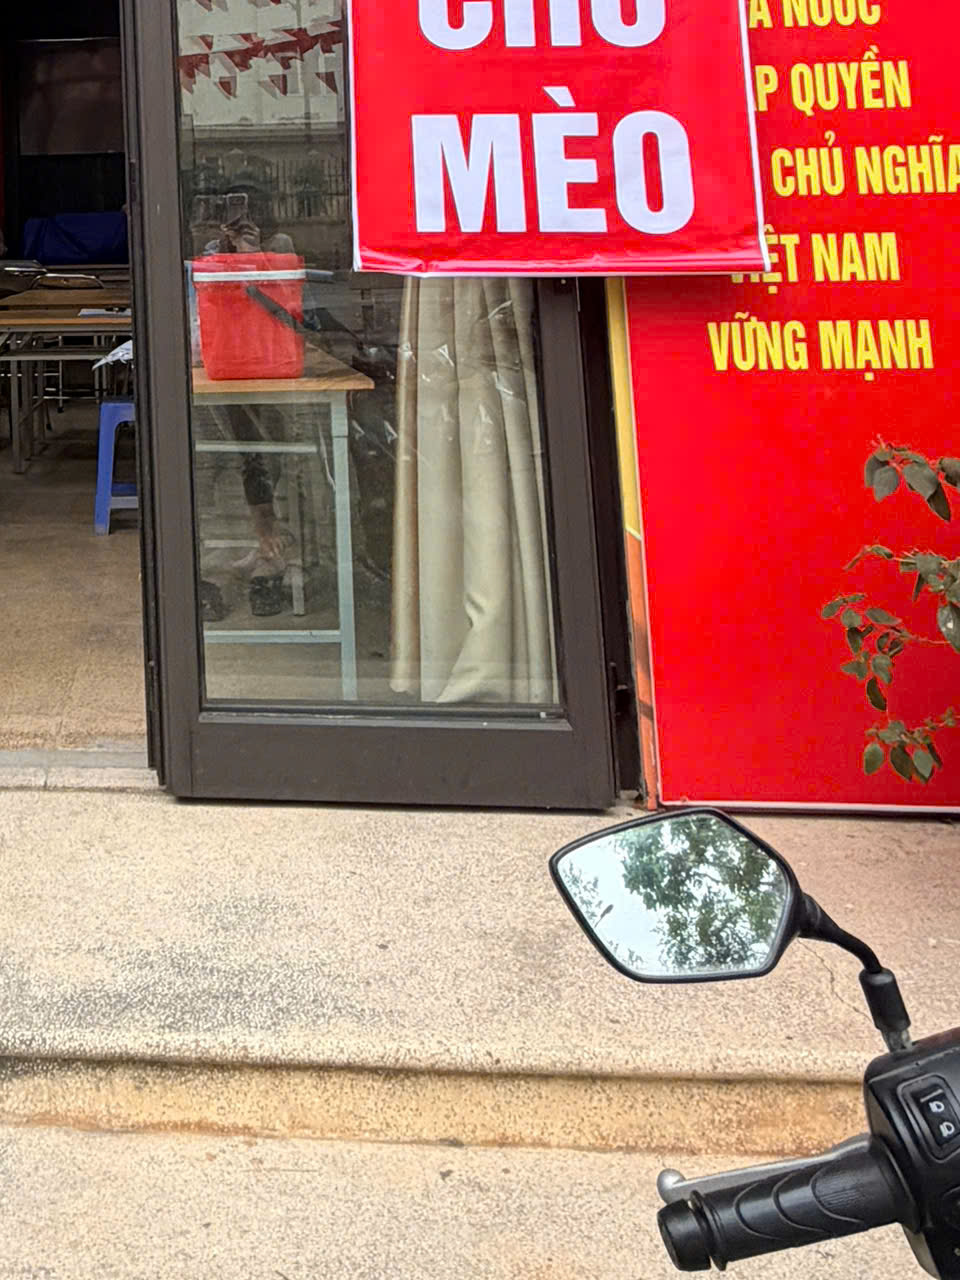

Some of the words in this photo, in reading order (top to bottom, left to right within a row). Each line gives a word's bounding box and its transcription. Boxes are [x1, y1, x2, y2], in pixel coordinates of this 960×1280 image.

[790, 45, 912, 117] QUYỀN
[411, 86, 695, 235] MÈO
[771, 130, 845, 197] CHỦ
[731, 224, 800, 294] ỆT
[811, 231, 901, 283] NAM
[707, 312, 809, 371] VỮNG
[818, 319, 934, 381] MẠNH
